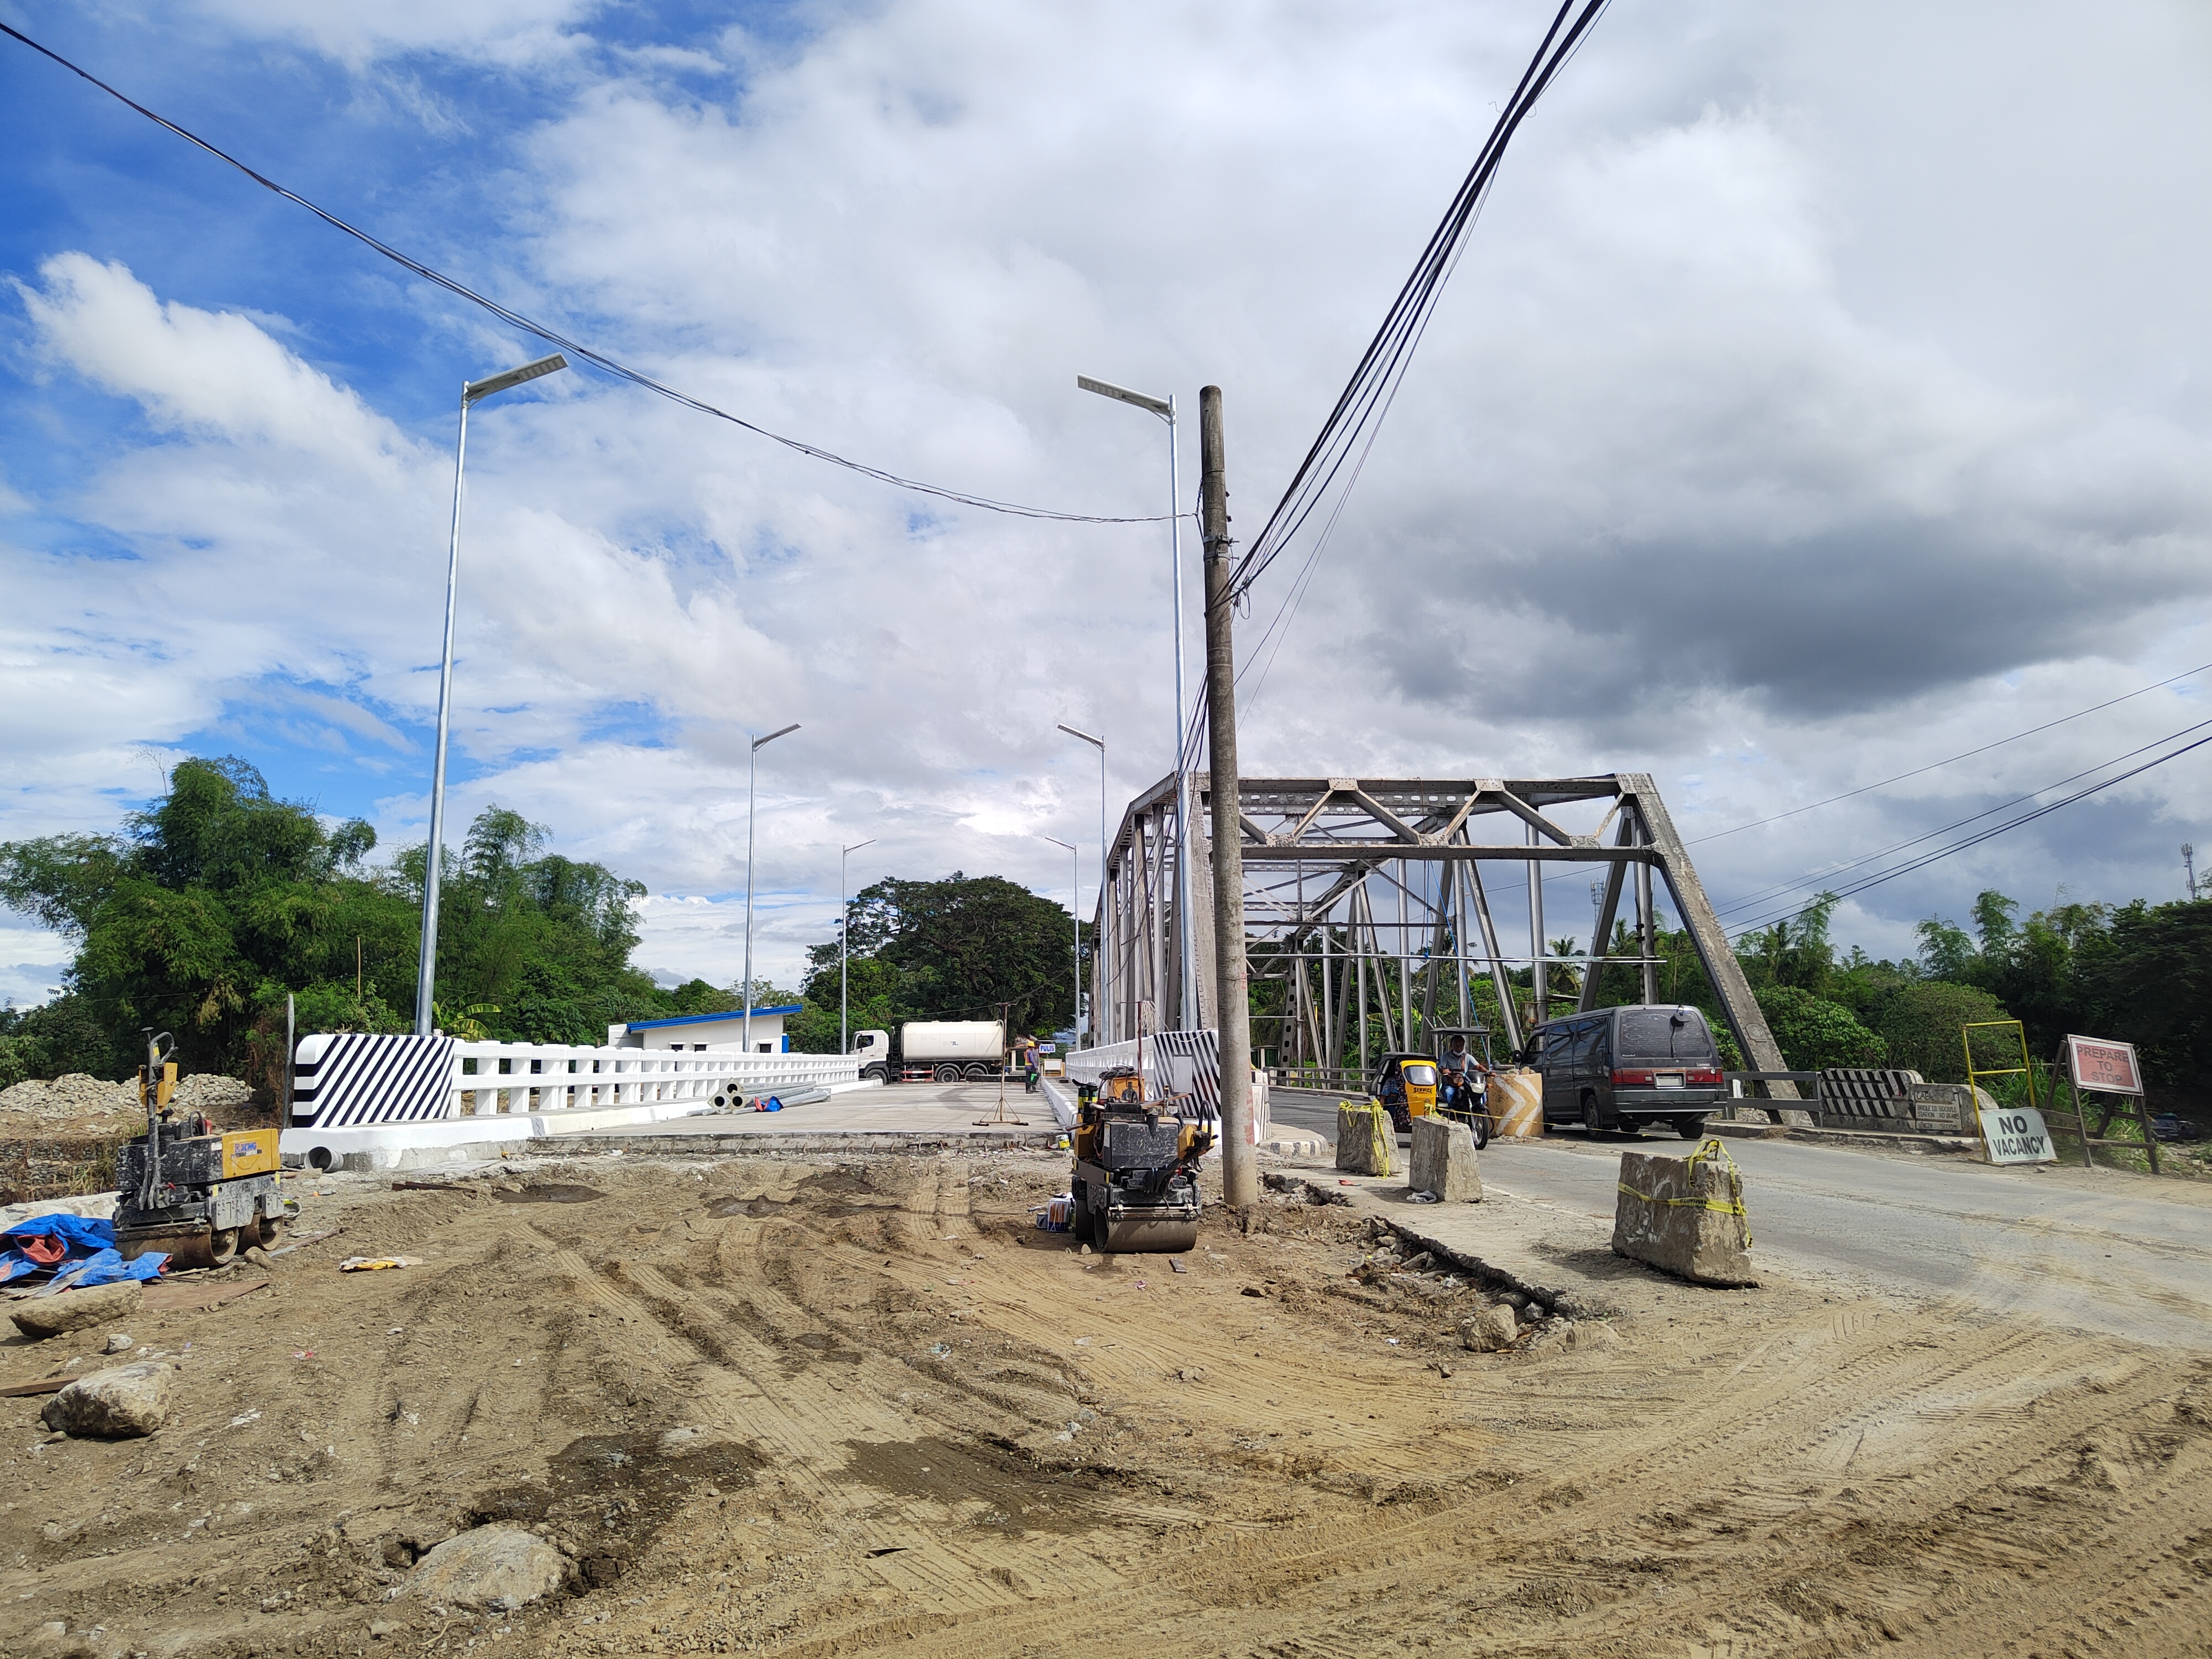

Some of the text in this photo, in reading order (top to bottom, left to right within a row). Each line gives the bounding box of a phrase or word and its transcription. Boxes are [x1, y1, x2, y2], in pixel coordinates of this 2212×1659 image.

[2077, 1046, 2130, 1062] PREPARE
[2096, 1061, 2113, 1072] TO
[2091, 1071, 2122, 1083] STOP
[1997, 1115, 2028, 1135] NO
[1992, 1135, 2046, 1156] VACANCY
